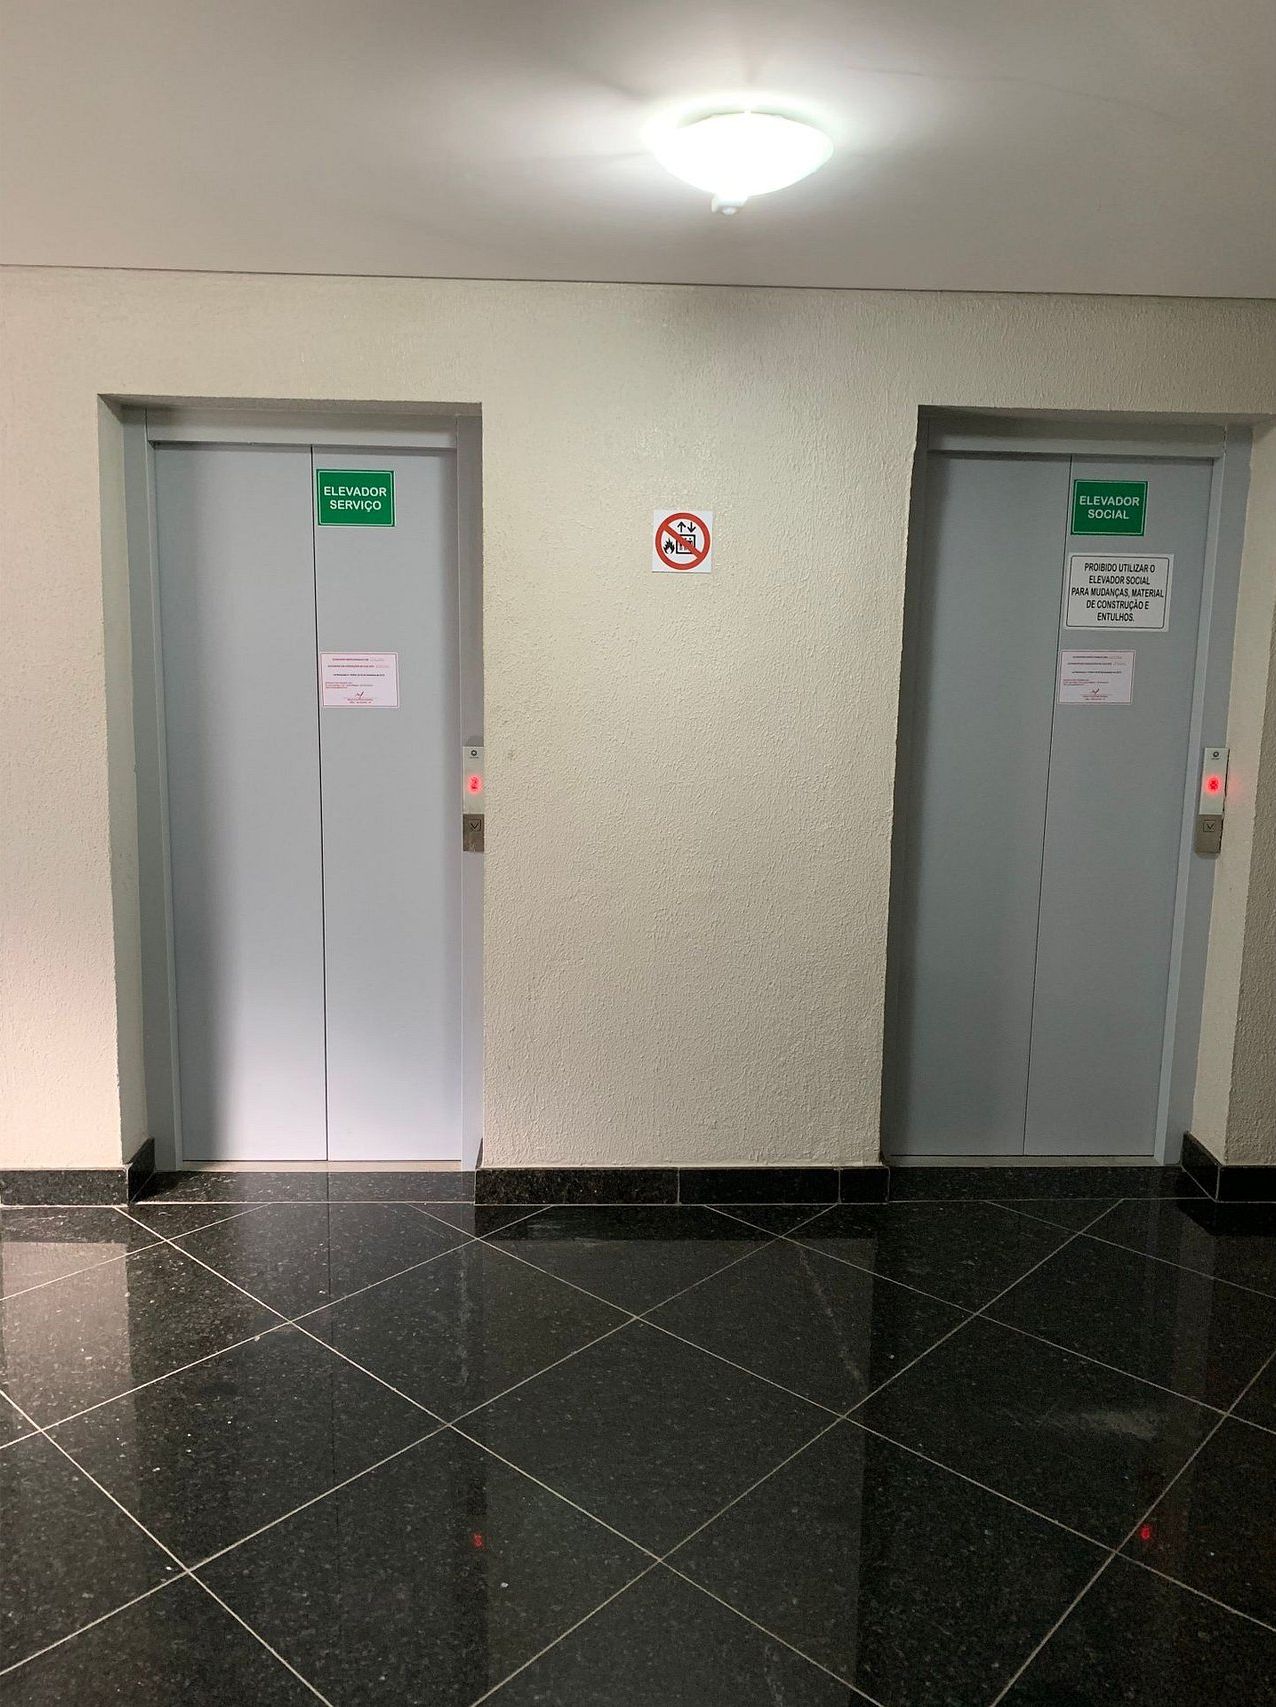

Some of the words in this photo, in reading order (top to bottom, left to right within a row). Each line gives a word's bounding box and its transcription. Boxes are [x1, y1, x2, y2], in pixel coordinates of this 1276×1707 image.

[323, 486, 387, 497] ELEVADOR
[329, 499, 382, 512] SERVIÇO
[1079, 495, 1140, 506] ELEVADOR
[1087, 509, 1130, 520] SOCIAL
[1084, 562, 1118, 572] PROIBIDO
[1118, 563, 1149, 573] UTILIZAR
[1149, 564, 1156, 573] O
[1088, 575, 1125, 585] ELEVADOR
[1125, 576, 1151, 585] SOCIAL
[1071, 587, 1089, 596] PARA
[1090, 587, 1130, 599] MUDANÇAS,
[1131, 588, 1164, 598] MATERIAL
[1086, 600, 1096, 609] DE
[1096, 598, 1144, 611] CONSTRUÇÃO
[1144, 601, 1150, 610] E
[1096, 612, 1135, 622] ENTULHOS.
